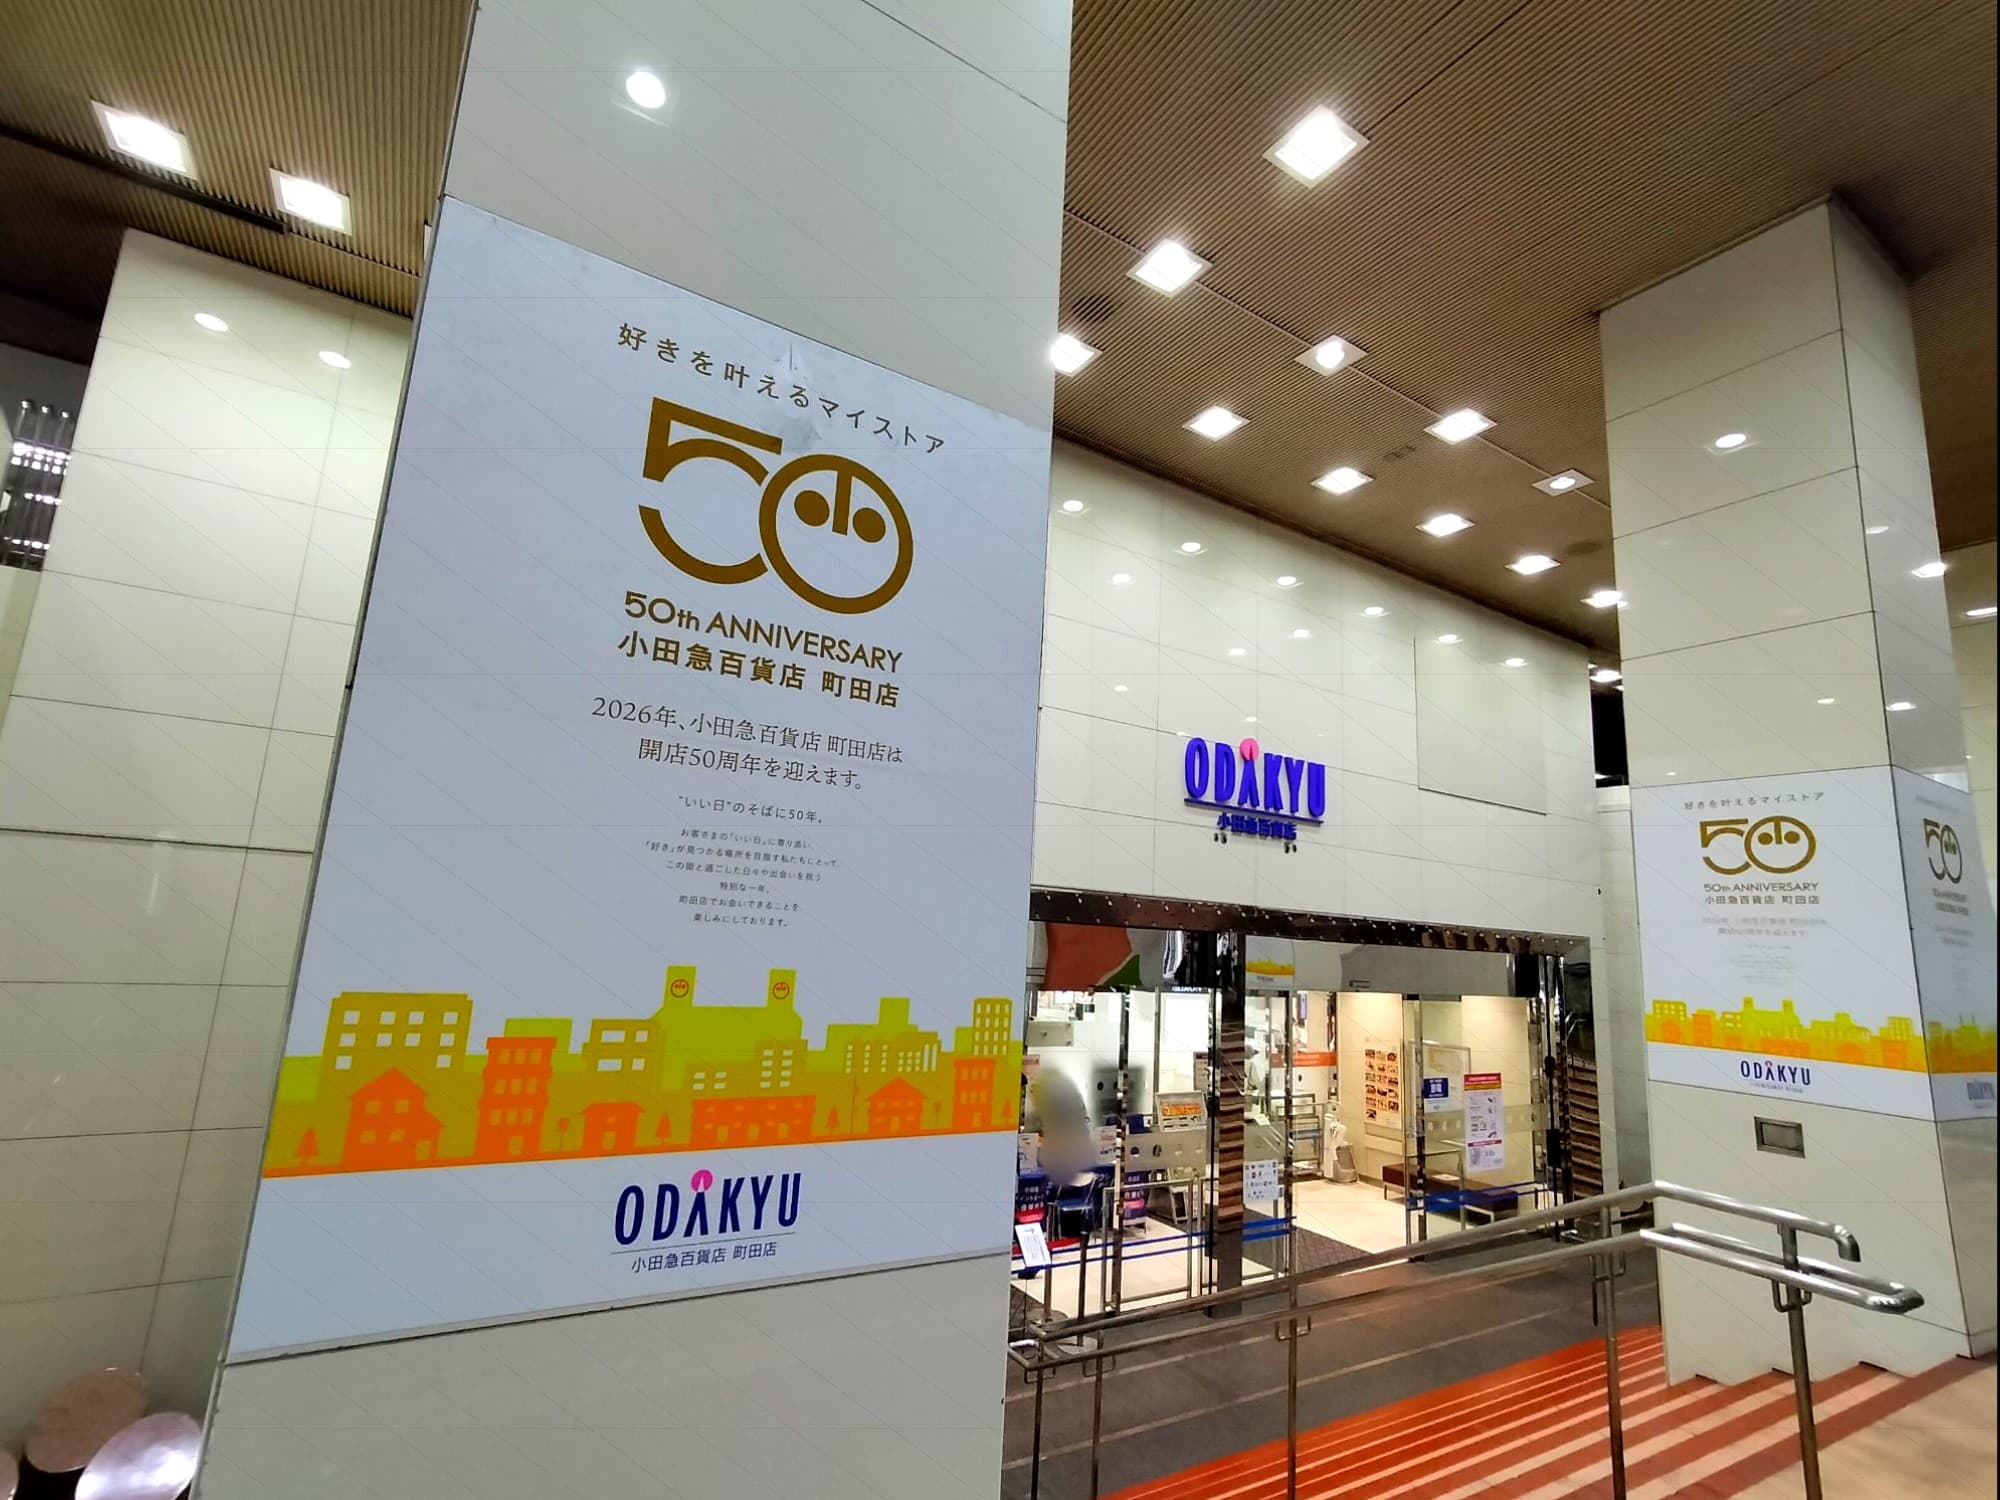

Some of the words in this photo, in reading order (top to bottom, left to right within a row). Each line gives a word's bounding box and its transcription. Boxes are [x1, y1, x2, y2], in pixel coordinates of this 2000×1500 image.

[618, 323, 944, 454] 好きを叶えるマイストア
[638, 397, 914, 615] 50
[617, 630, 807, 690] 小田急百貨店
[821, 671, 900, 708] 町田店
[625, 591, 700, 631] 50th
[705, 611, 903, 673] ANNIVERSARY
[592, 697, 822, 752] 2026年、小田急百貨店
[827, 735, 903, 763] 町田店は
[638, 738, 862, 790] 開店50周年を迎えます。
[1185, 737, 1326, 818] ODAKYU
[1733, 882, 1819, 892] ANNIVERSARY
[1740, 1060, 1811, 1086] ODAKYU
[615, 1169, 801, 1246] ODAKYU
[631, 1248, 726, 1274] 小田急百貨店
[732, 1242, 778, 1260] 町田店
